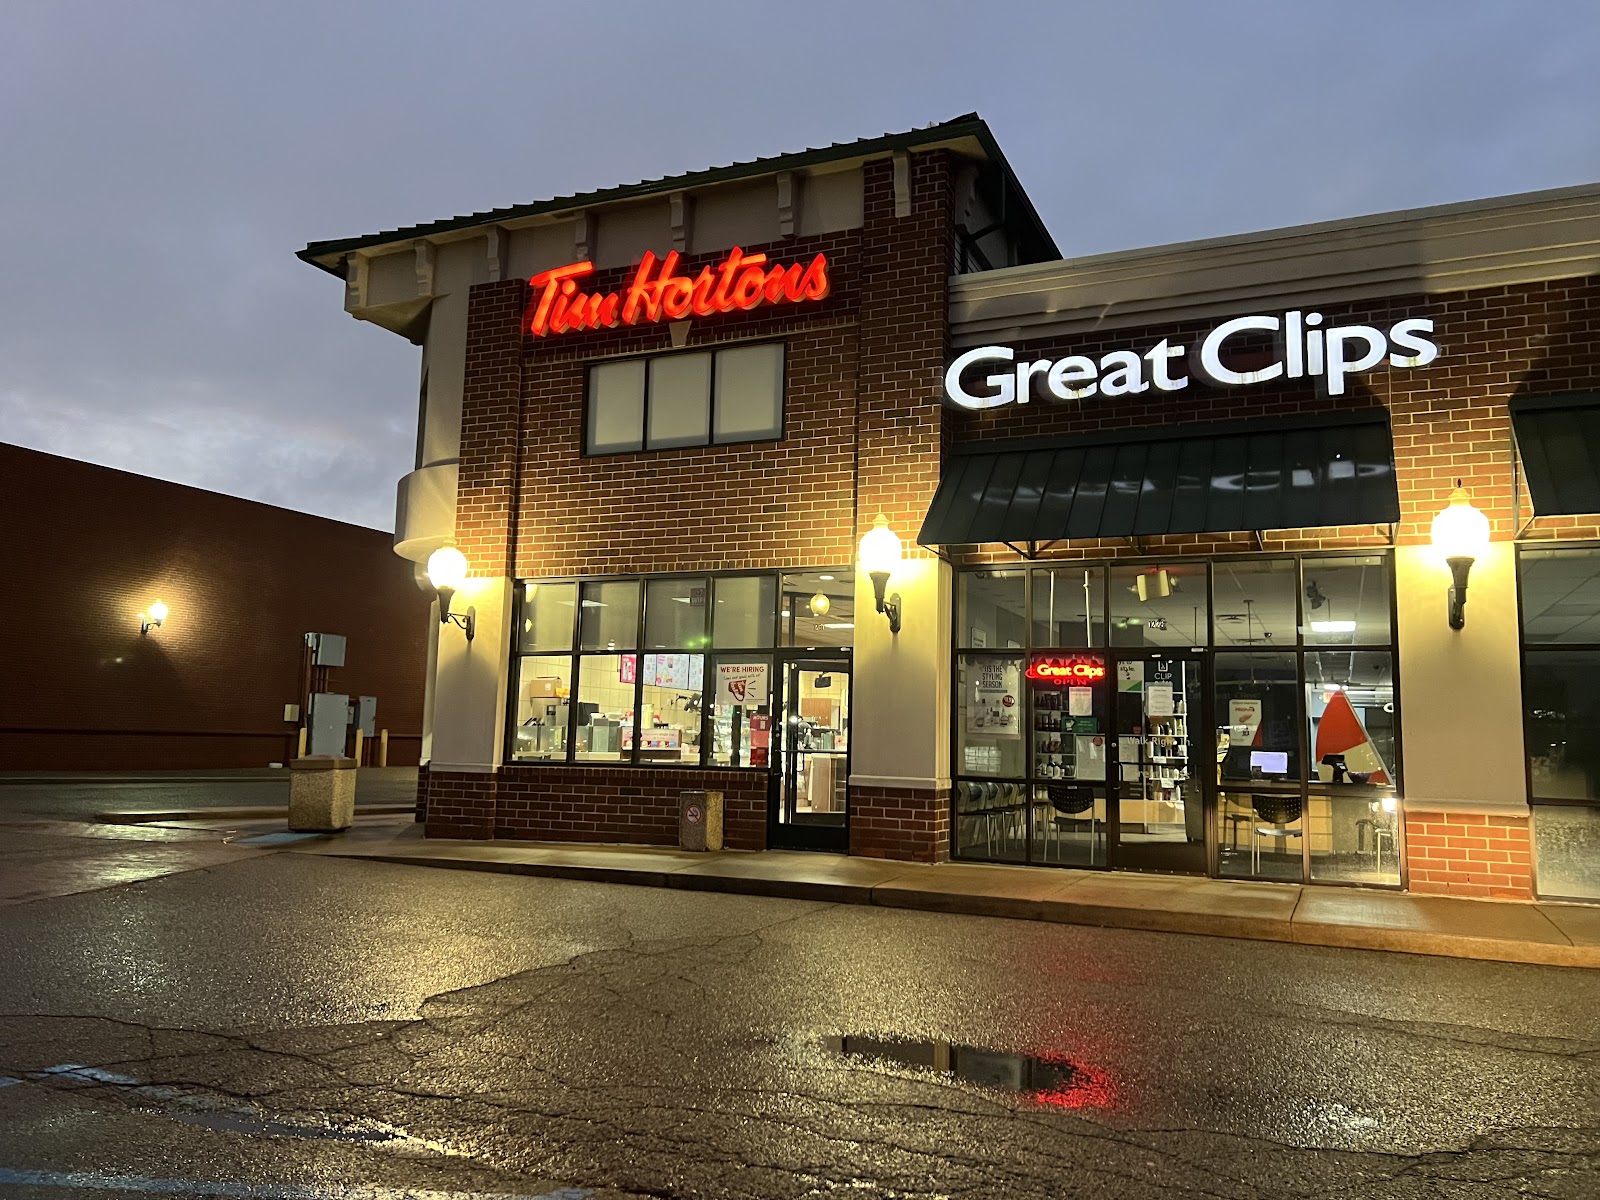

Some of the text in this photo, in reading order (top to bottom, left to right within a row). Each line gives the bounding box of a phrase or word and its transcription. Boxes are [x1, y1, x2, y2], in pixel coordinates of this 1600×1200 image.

[529, 246, 830, 337] Tim Hortons
[945, 311, 1438, 410] Great Clips
[1037, 664, 1104, 679] Great Clips
[1152, 736, 1175, 747] Righ
